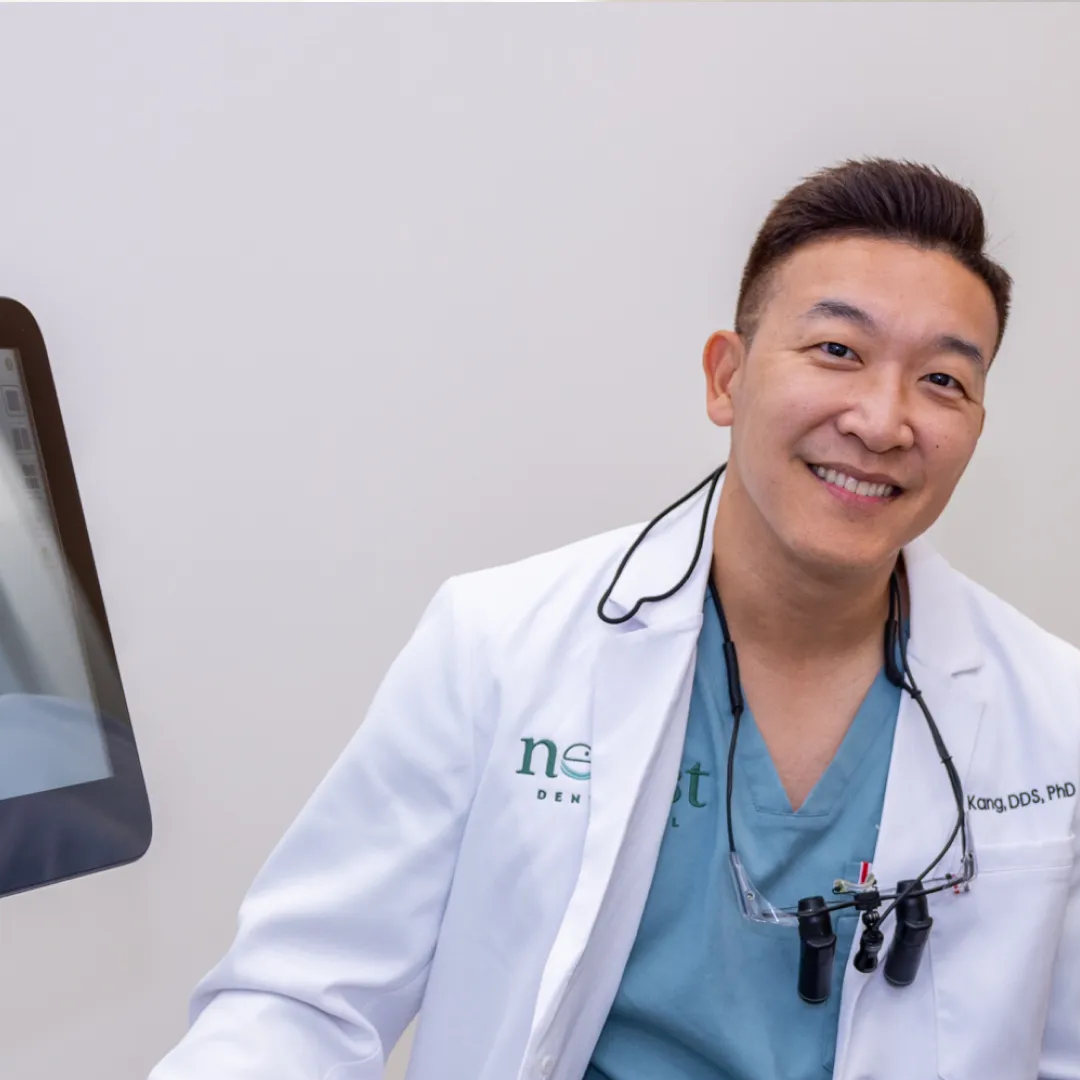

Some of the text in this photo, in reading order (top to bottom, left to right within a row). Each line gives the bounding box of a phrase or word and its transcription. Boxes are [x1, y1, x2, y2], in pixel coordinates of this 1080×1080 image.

[537, 789, 591, 804] DEN
[967, 795, 1007, 813] Kang,
[1046, 782, 1076, 801] PhD
